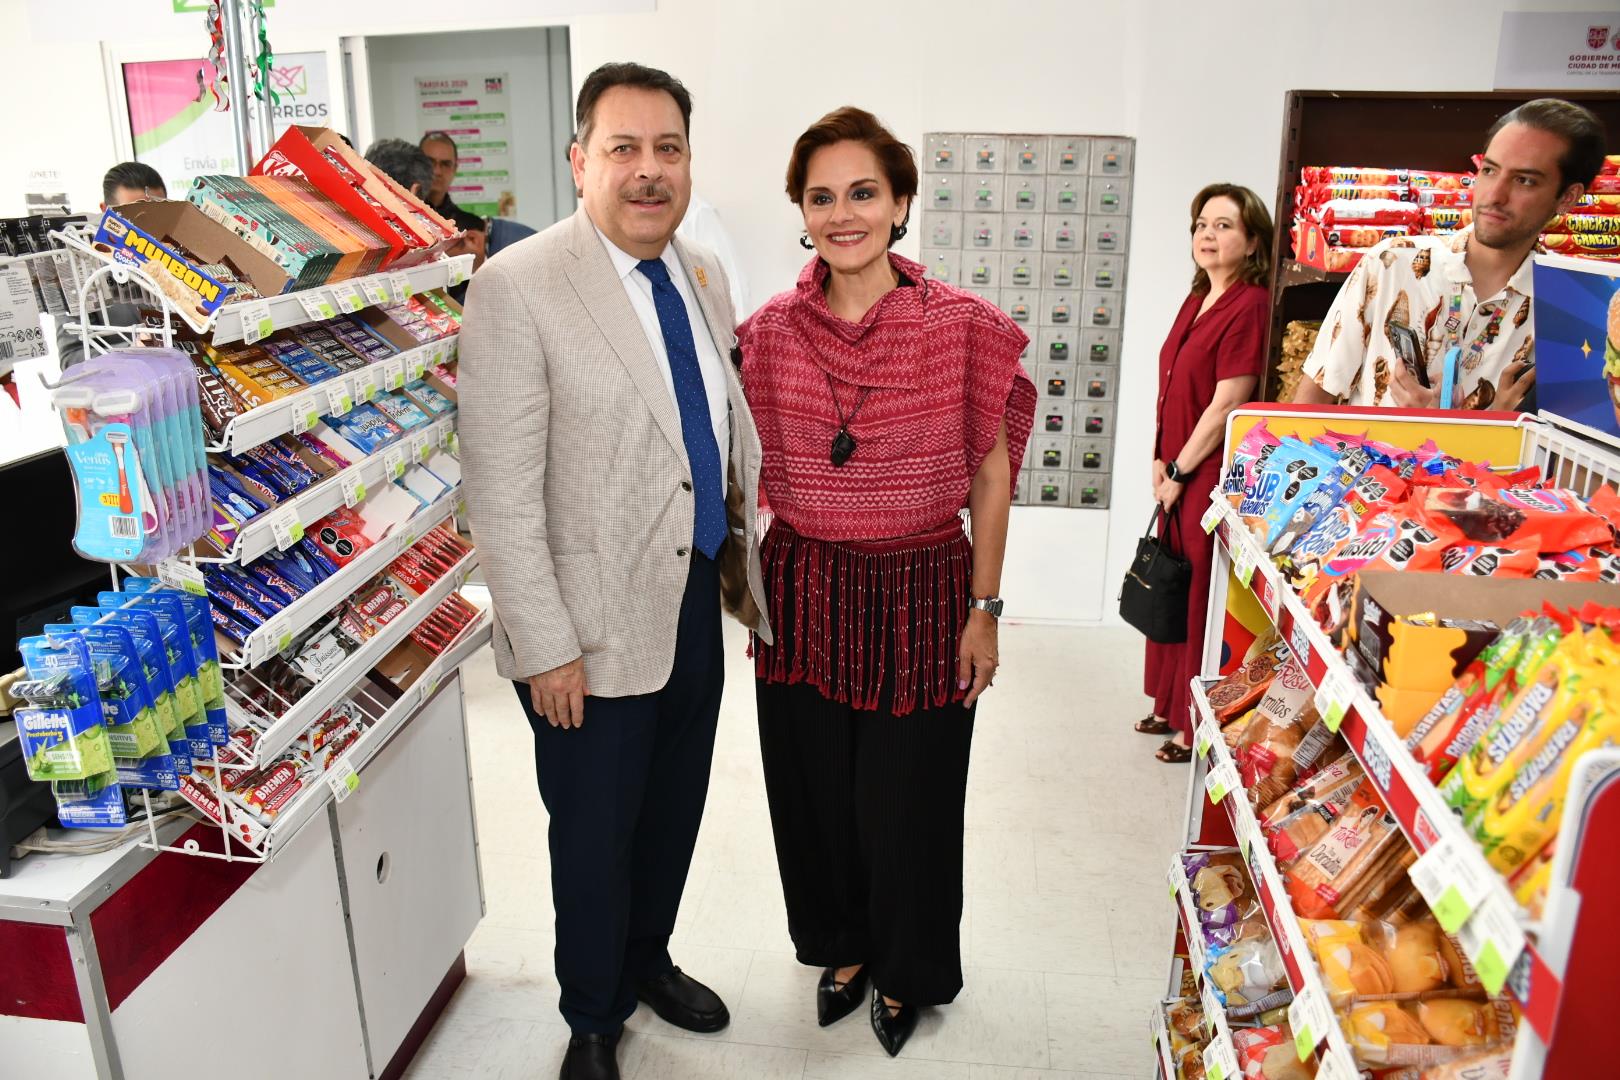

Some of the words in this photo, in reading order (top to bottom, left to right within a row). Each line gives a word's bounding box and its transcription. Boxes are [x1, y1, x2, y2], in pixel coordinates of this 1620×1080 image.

[248, 103, 328, 119] CRREOS
[1245, 472, 1281, 502] SUB
[364, 590, 390, 614] BREMEN
[382, 602, 404, 622] BREMEN
[23, 713, 69, 731] Gillette
[1488, 681, 1553, 764] BARRITAS
[57, 732, 64, 742] 3
[254, 767, 292, 801] BREMEN
